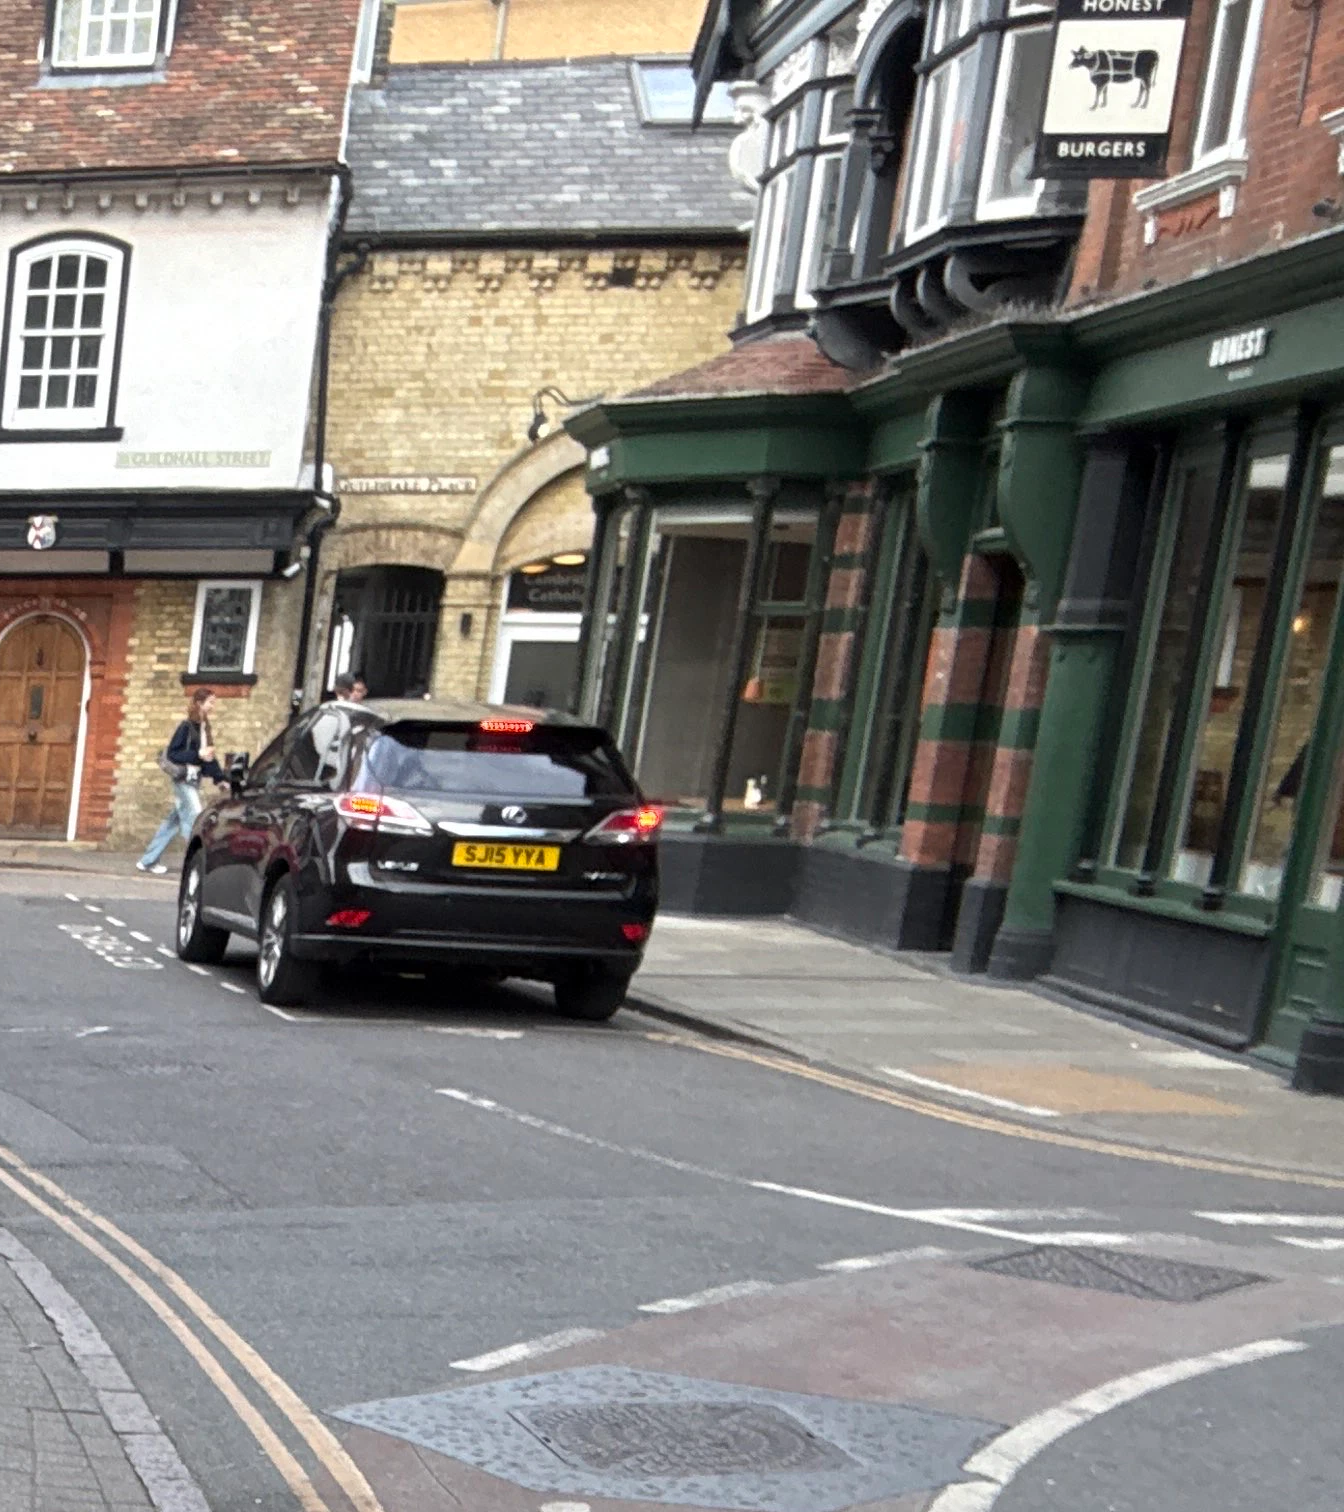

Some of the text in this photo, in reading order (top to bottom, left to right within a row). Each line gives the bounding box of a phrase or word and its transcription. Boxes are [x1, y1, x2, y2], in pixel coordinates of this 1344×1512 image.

[1082, 0, 1163, 12] HONEST
[1056, 140, 1146, 158] BURGERS
[131, 451, 269, 466] GUILDHALL STREET
[465, 845, 545, 865] SJ15 YYA
